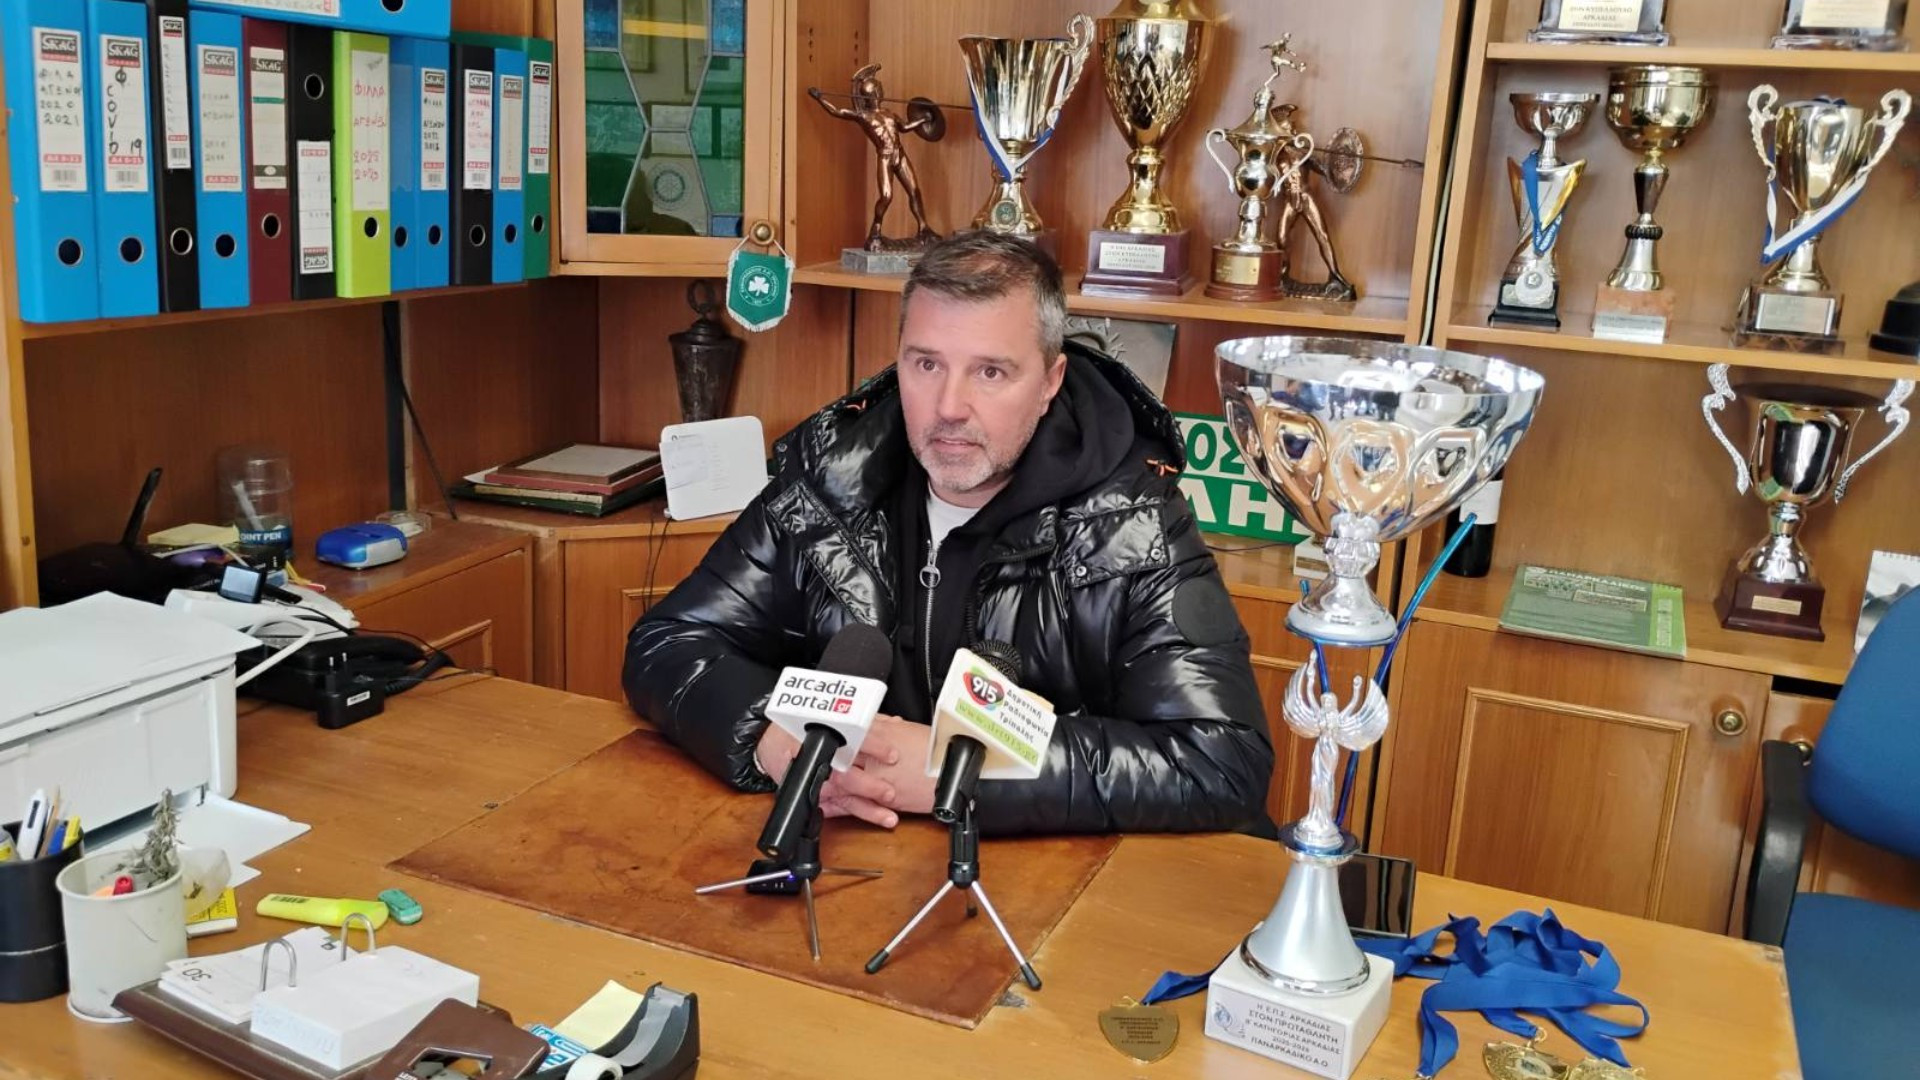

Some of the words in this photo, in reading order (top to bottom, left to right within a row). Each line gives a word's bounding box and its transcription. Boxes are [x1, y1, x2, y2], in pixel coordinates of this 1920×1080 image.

[42, 35, 77, 52] SKAG
[108, 42, 139, 58] SKAG
[204, 51, 234, 66] SKAG
[255, 58, 281, 71] SKAG
[43, 113, 80, 127] 2021
[130, 138, 143, 159] 19
[263, 531, 282, 541] PEN
[784, 676, 857, 698] arcadia
[972, 676, 998, 703] 915
[1249, 1009, 1274, 1023] ΣΤΟΝ
[1275, 1017, 1338, 1044] ΠΡΩΤΑΘΛΗΤΗ
[1289, 1013, 1331, 1032] ΑΡΚΑΔΙΑΣ
[1253, 1022, 1301, 1042] ΚΑΤΗΓΟΡΙΑΣ
[1301, 1035, 1342, 1055] ΑΡΚΑΔΙΑΣ
[1251, 1036, 1313, 1064] ΠΑΝΑΡΚΑΔΙΚΟ
